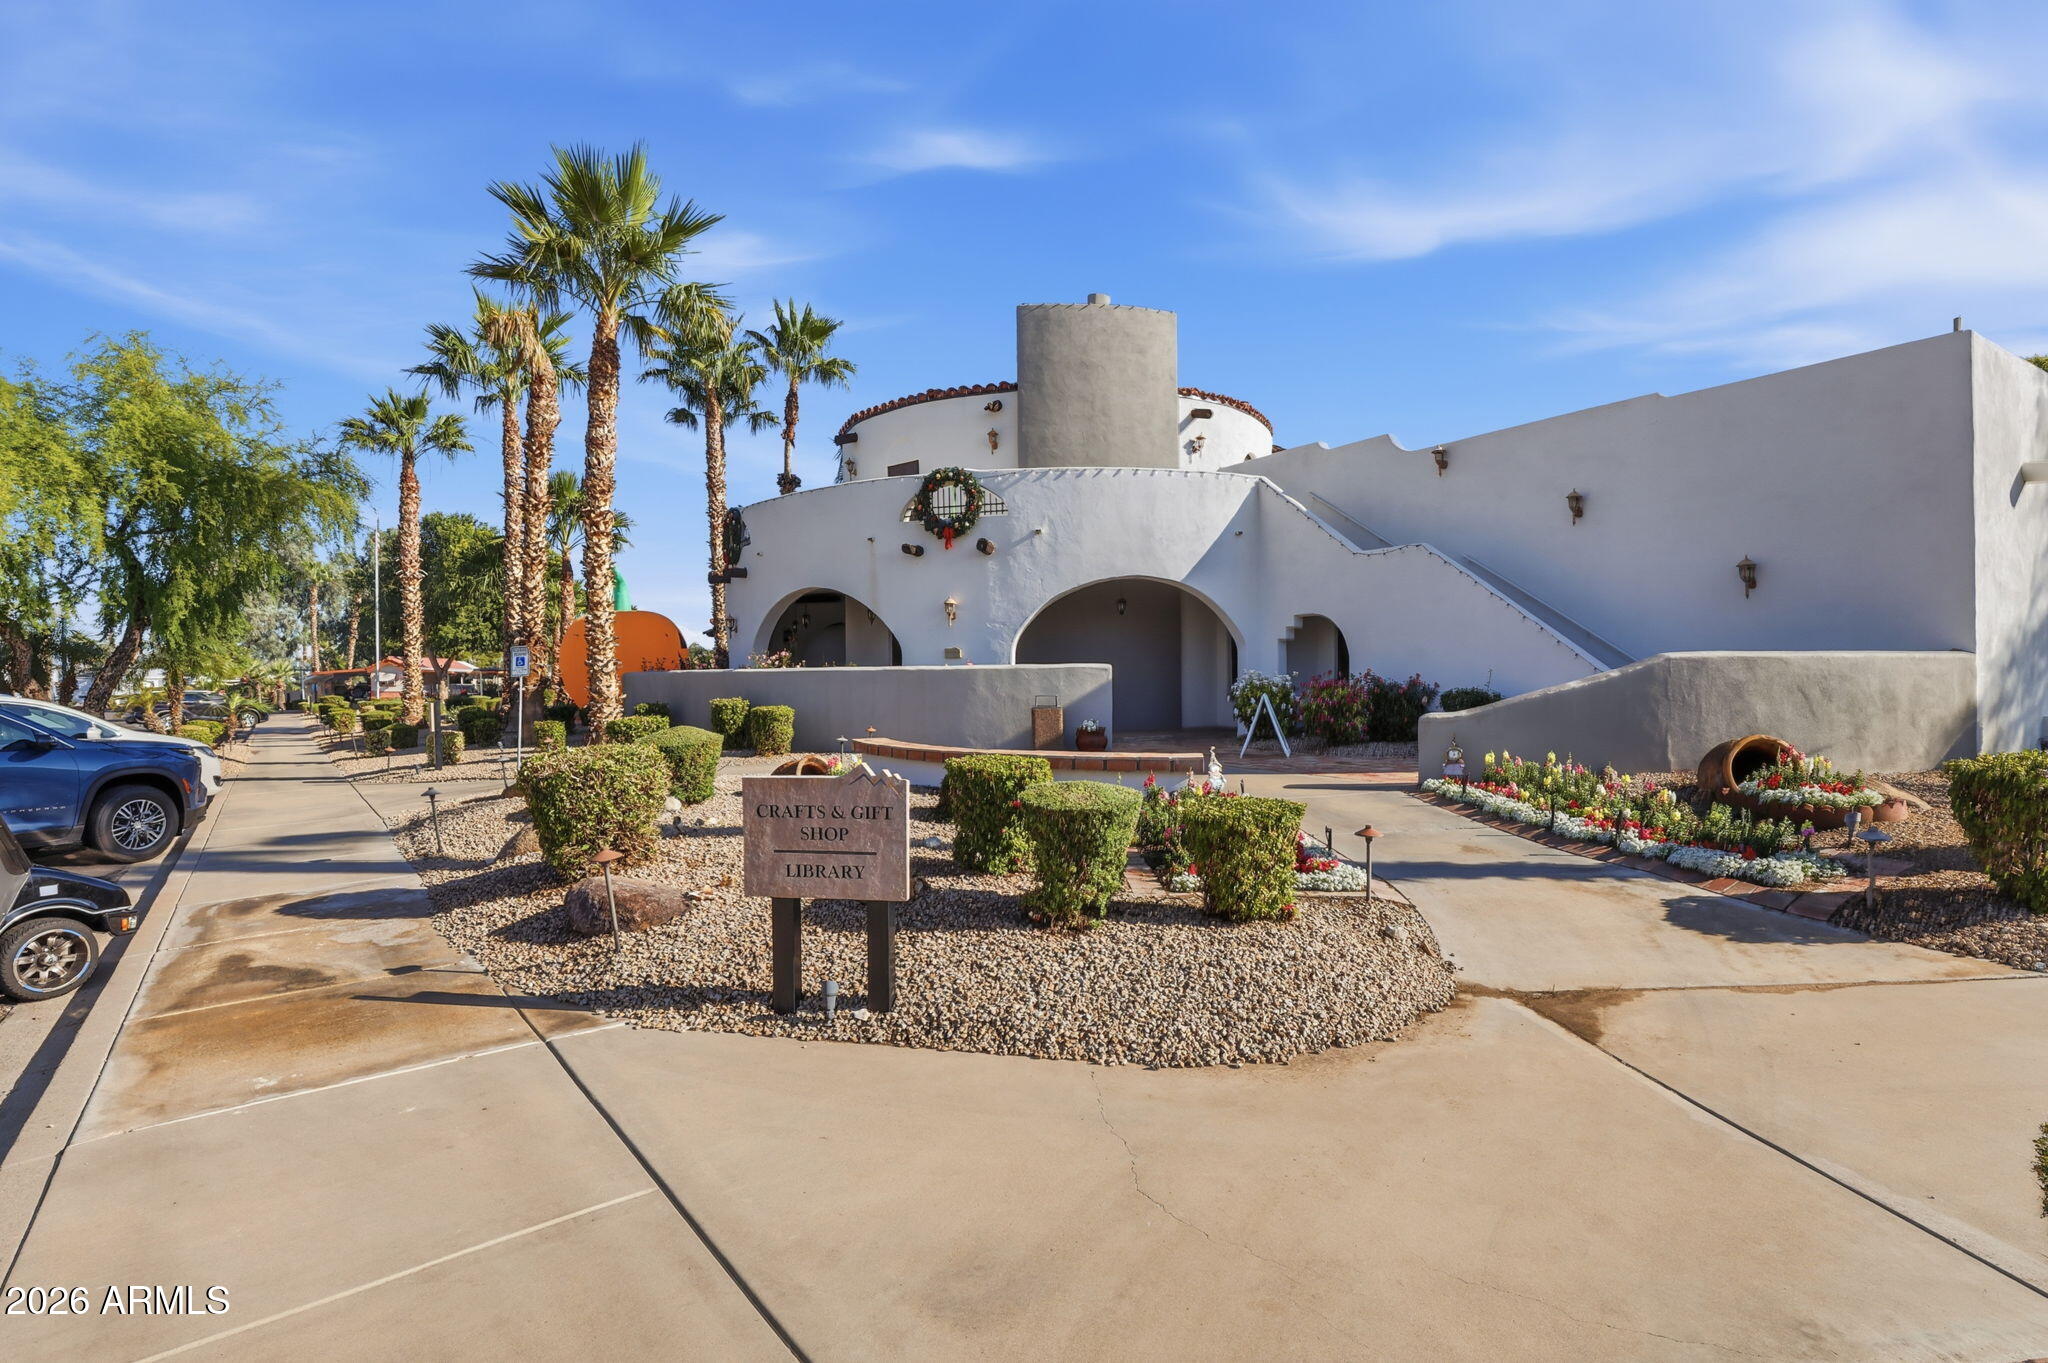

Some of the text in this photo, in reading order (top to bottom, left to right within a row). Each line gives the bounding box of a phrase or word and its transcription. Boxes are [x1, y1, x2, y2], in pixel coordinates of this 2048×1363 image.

[756, 803, 894, 820] CRAFTS & GIFT
[800, 826, 849, 841] SHOP
[785, 863, 865, 880] LIBRARY
